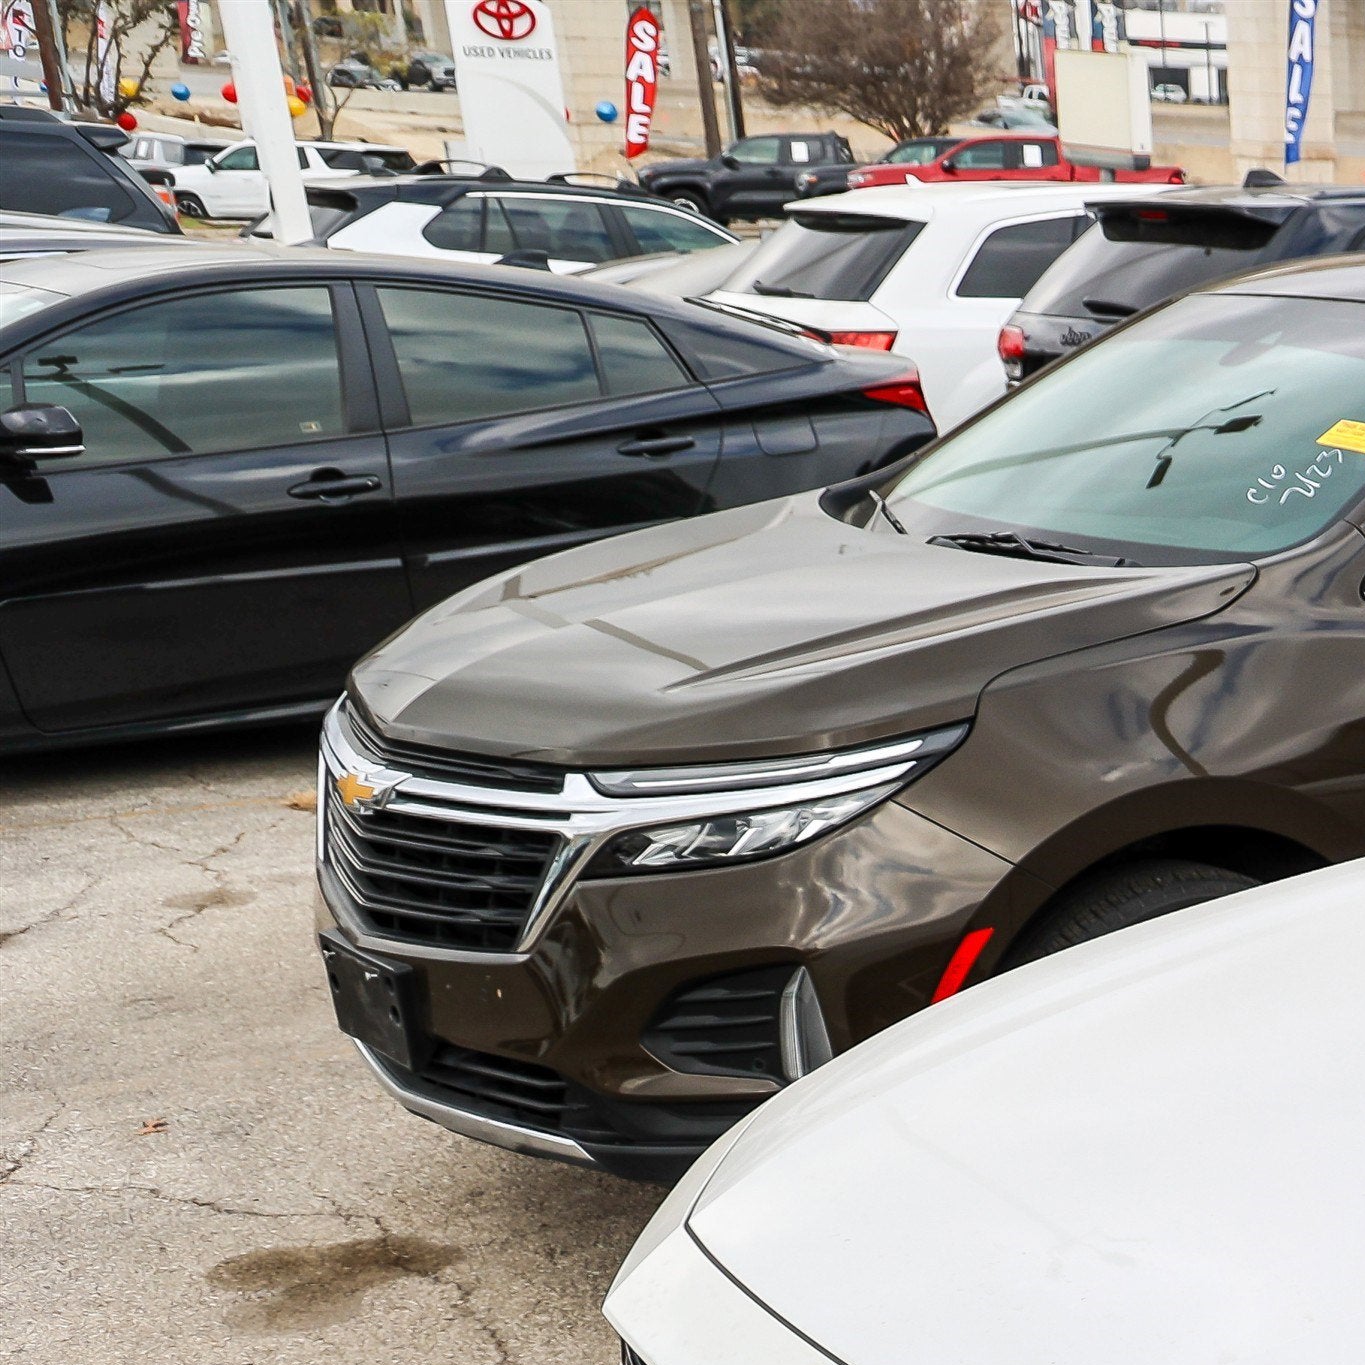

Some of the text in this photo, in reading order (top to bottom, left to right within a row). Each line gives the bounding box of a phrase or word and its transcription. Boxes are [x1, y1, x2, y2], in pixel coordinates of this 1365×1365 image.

[462, 45, 554, 61] USED VEHICLES
[625, 20, 659, 144] SALE
